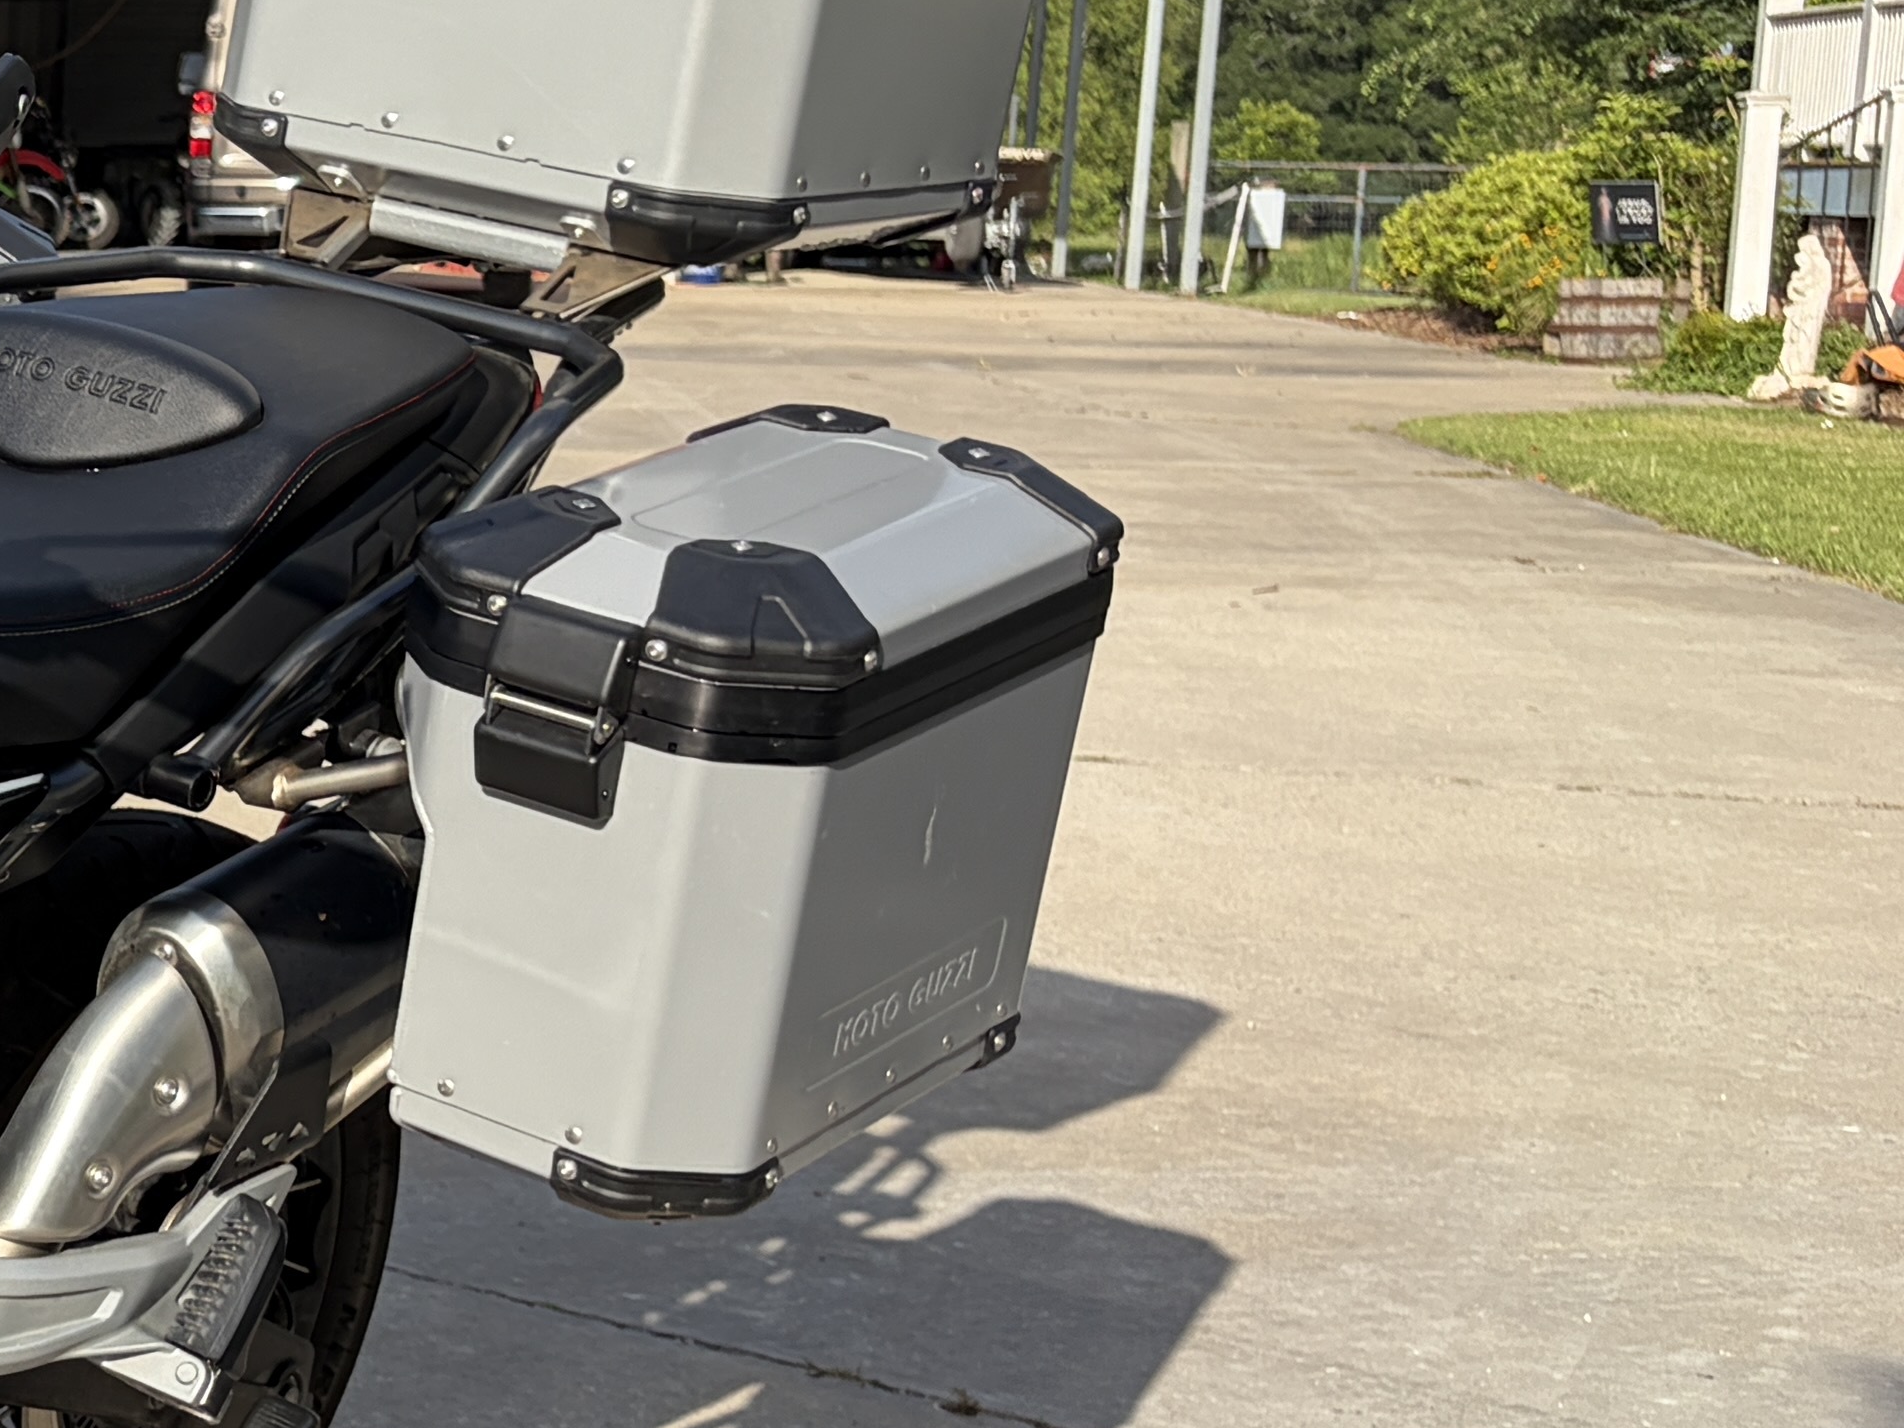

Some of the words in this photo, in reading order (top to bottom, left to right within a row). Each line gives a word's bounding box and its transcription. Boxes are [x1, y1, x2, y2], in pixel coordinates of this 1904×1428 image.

[64, 366, 167, 415] GUZZI
[832, 991, 903, 1058] MOTO
[908, 947, 977, 1014] GUZZI
